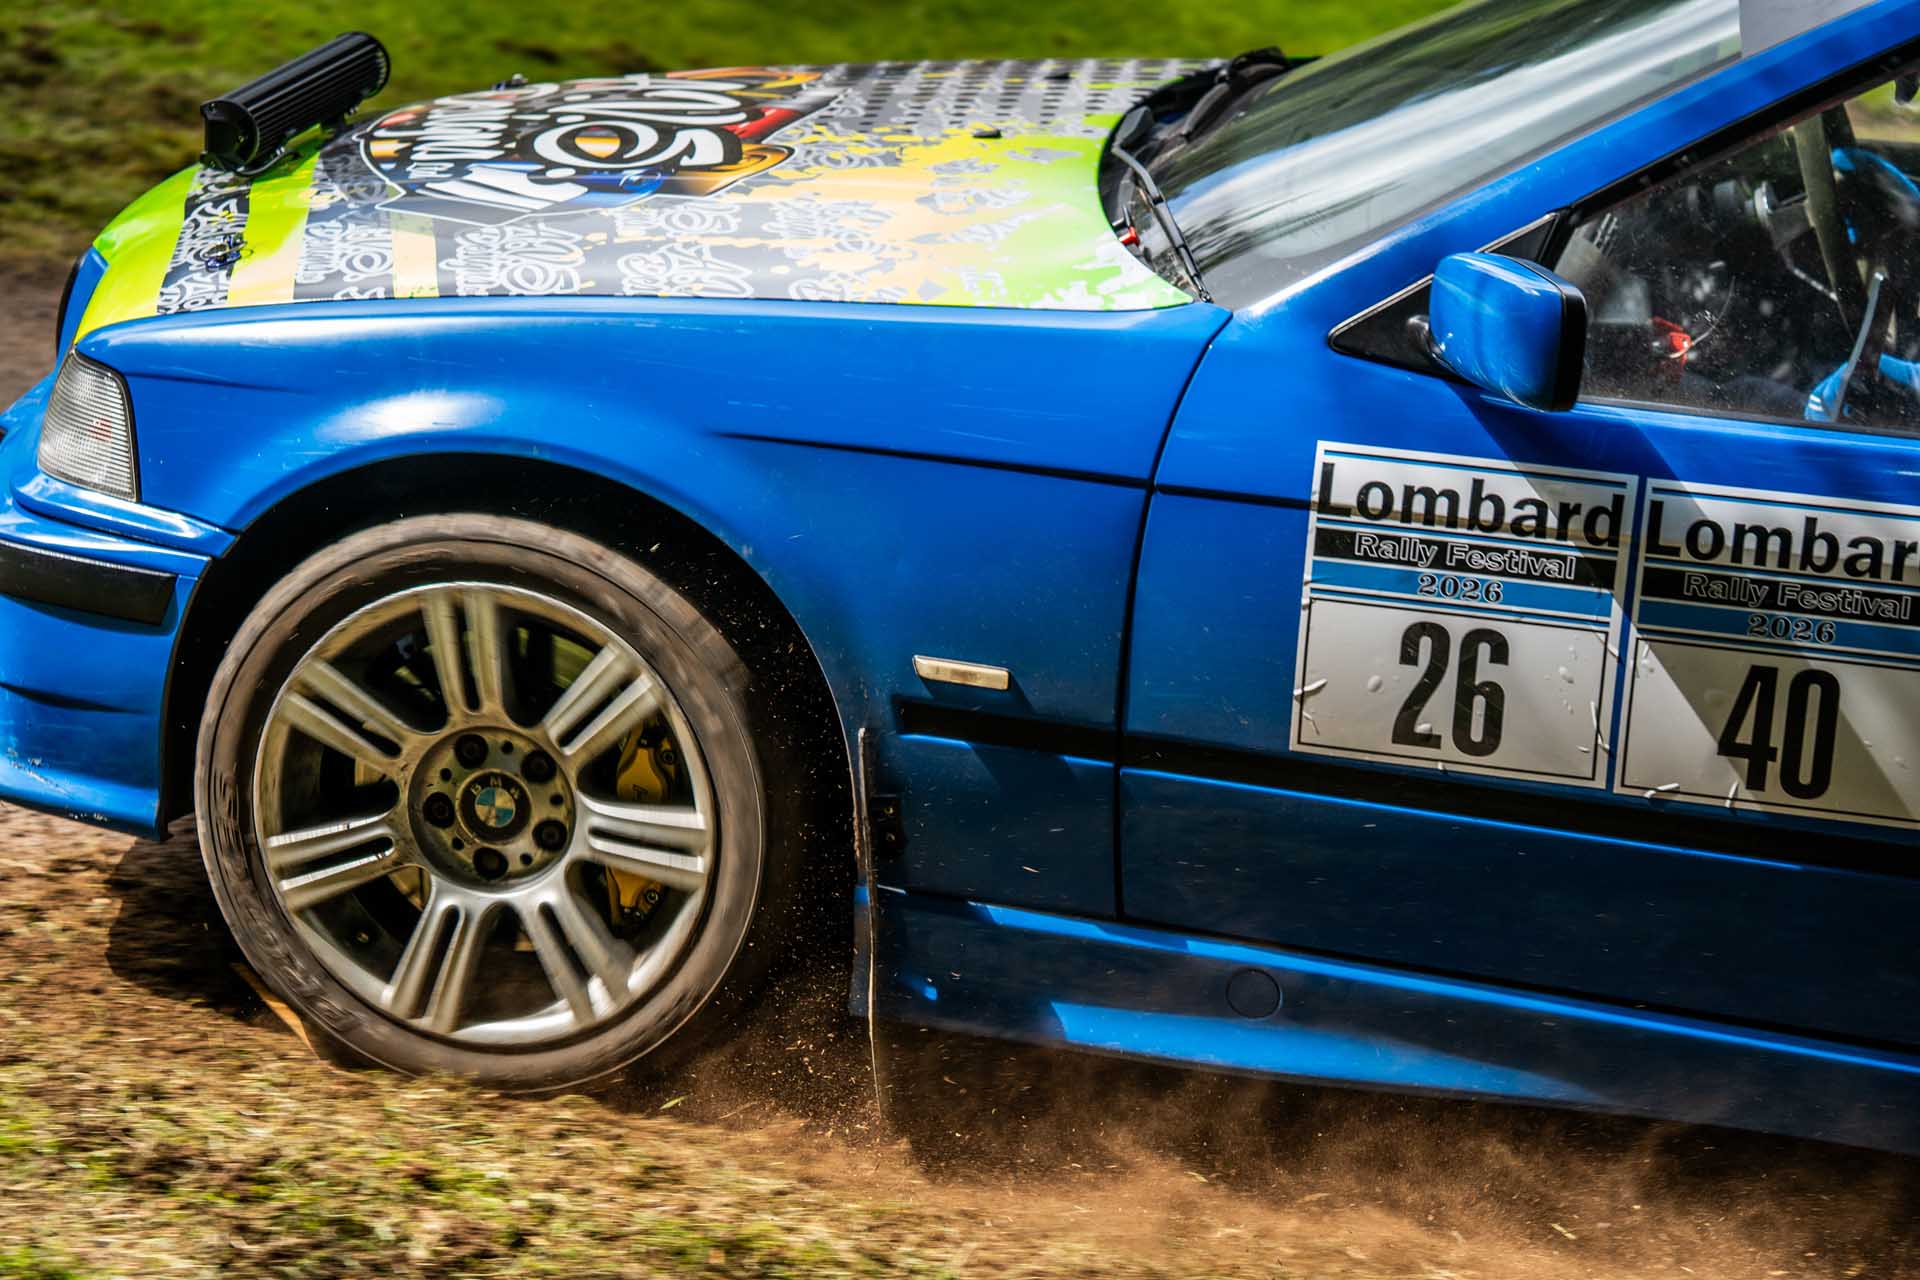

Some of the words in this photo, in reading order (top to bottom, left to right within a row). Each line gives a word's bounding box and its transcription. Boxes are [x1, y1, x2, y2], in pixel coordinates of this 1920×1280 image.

[1316, 461, 1625, 548] Lombard
[1354, 532, 1438, 568] Rally
[1446, 541, 1576, 580] Festival
[1645, 500, 1920, 582] Lombar
[1417, 573, 1504, 604] 2026
[1683, 572, 1769, 608] Rally
[1777, 582, 1911, 620] Festival
[1748, 614, 1837, 645] 2026
[1391, 621, 1510, 757] 26
[1717, 665, 1840, 799] 40
[469, 775, 521, 802] BMW
